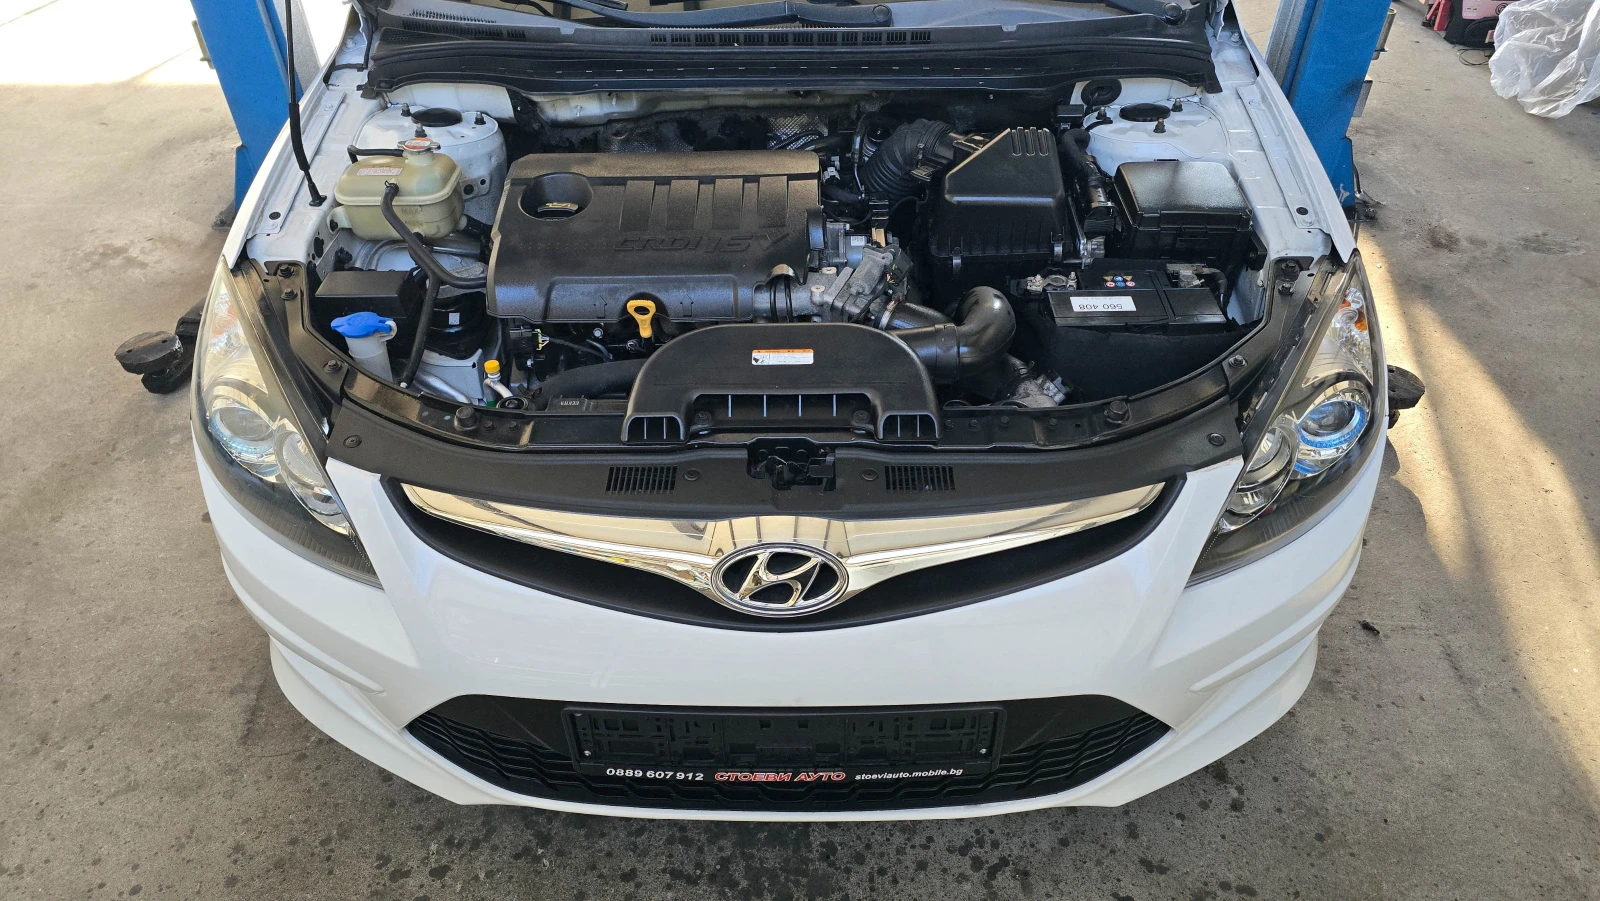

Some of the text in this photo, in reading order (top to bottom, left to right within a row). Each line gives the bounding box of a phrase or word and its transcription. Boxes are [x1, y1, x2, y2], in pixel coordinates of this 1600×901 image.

[606, 768, 704, 780] 0889 607 912
[714, 771, 846, 781] СТОЕВИ АУТО
[854, 768, 964, 780] stoeviauto.mobile.bg
